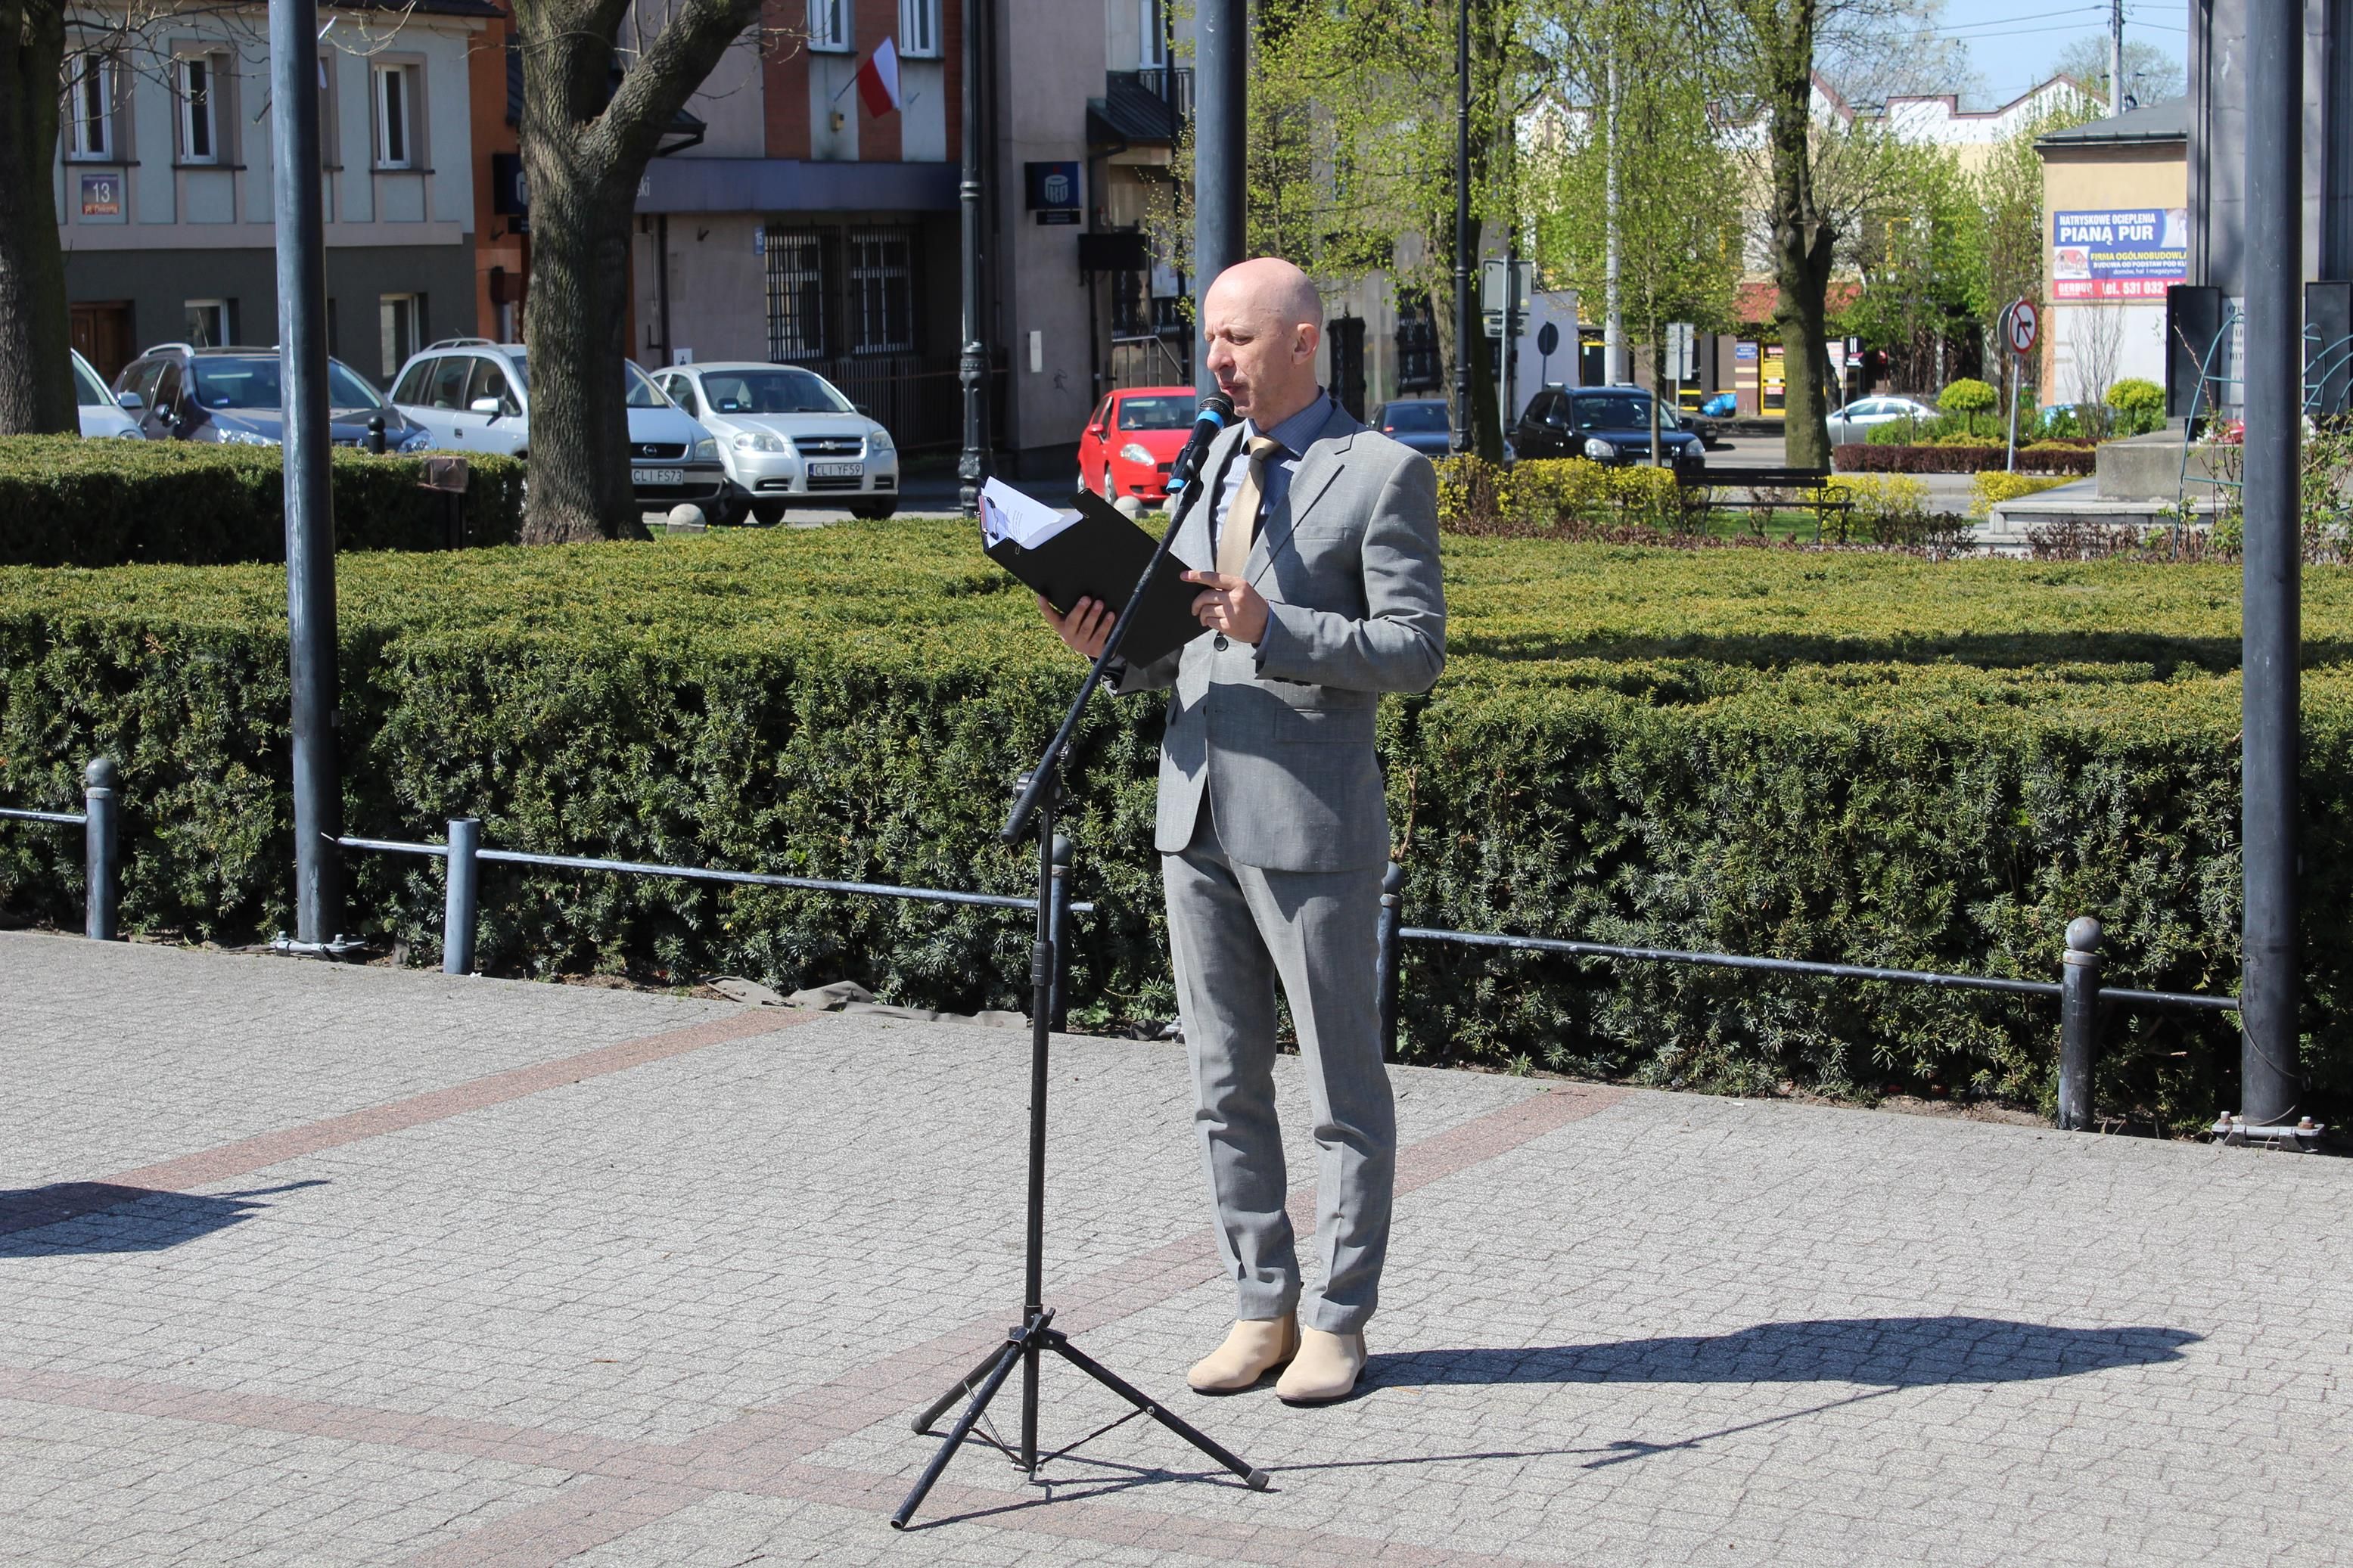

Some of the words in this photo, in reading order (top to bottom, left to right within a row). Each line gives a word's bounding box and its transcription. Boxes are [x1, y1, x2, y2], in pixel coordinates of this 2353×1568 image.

[93, 182, 110, 203] 13
[2059, 214, 2111, 226] NATRYSKOWE
[2112, 213, 2156, 225] OCIEPLENIA
[2060, 226, 2114, 246] PIANĄ
[2119, 225, 2154, 241] PUR
[2090, 252, 2115, 261] FIRMA
[2102, 281, 2119, 295] tel.
[2122, 281, 2141, 294] 531
[2143, 281, 2165, 294] 032
[657, 470, 682, 482] FS73
[838, 464, 861, 475] YF59
